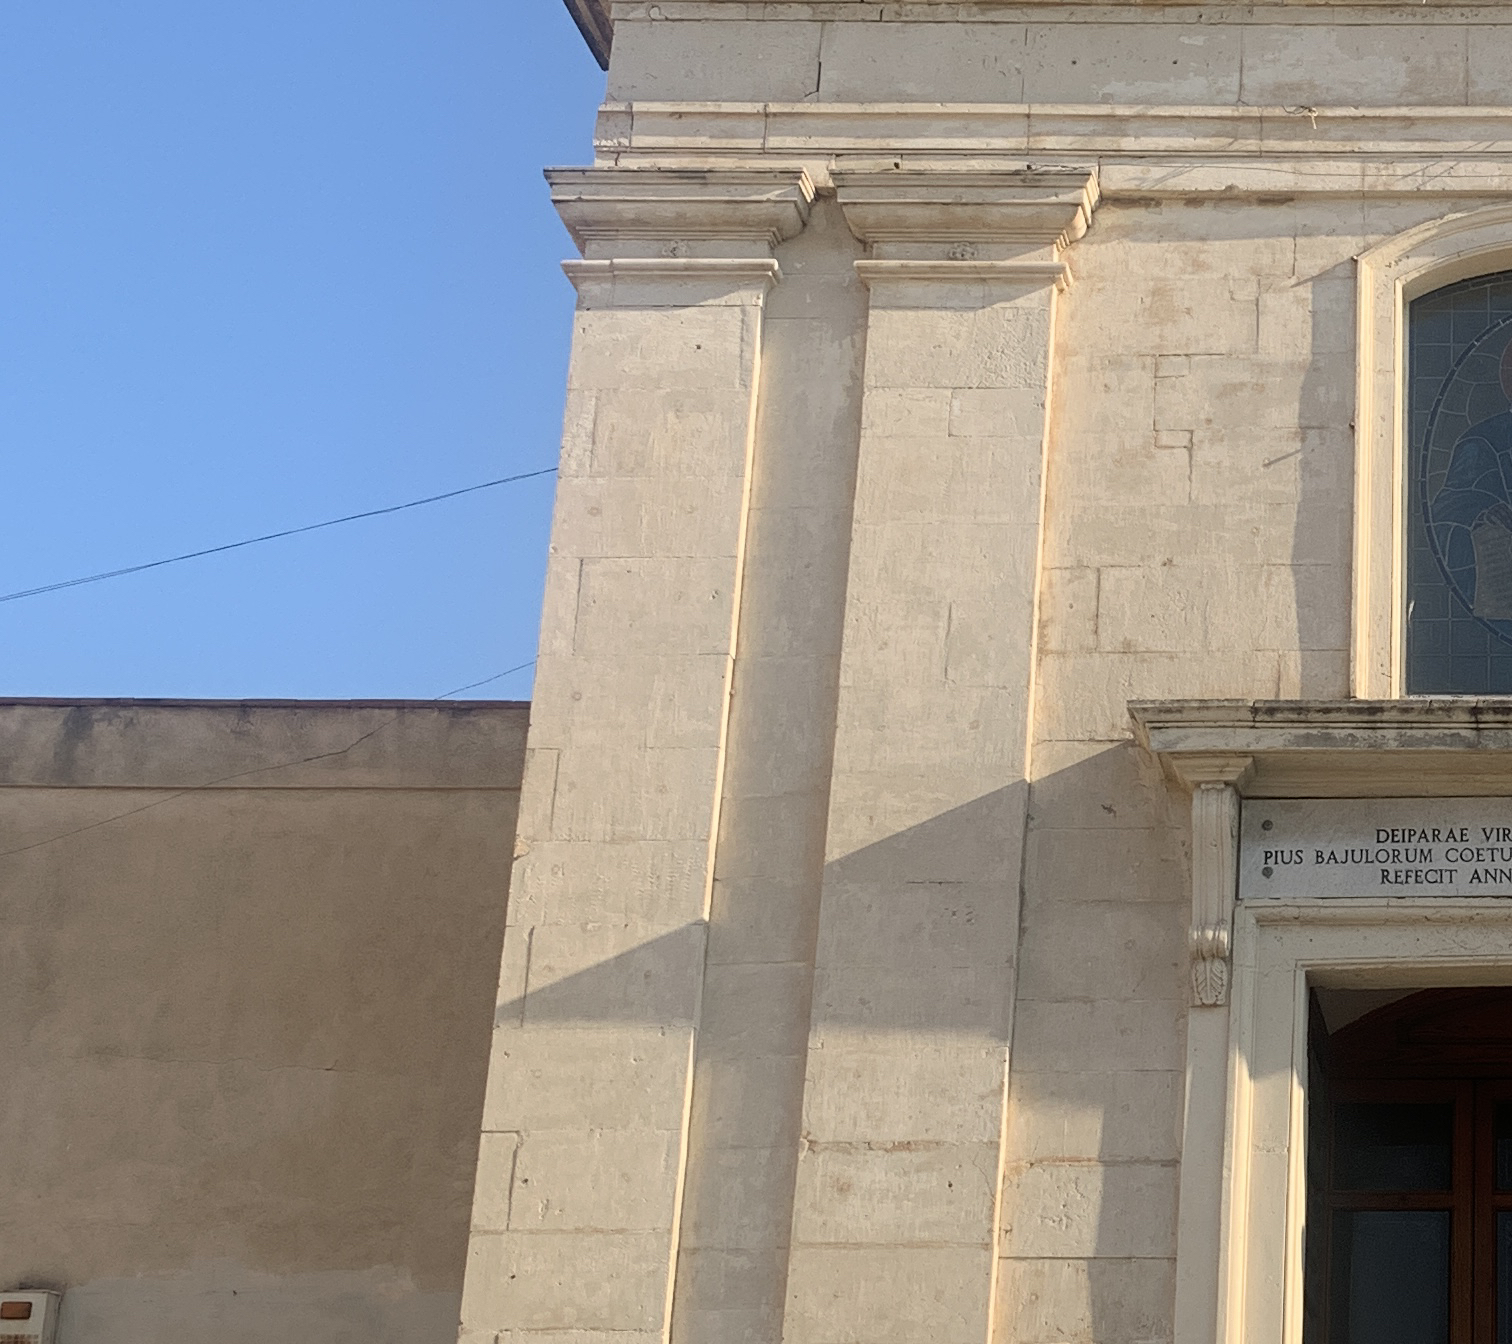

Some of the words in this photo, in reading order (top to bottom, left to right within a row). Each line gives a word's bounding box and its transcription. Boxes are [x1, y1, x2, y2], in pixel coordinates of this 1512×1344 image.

[1375, 828, 1470, 844] DEIPARAE
[1263, 849, 1304, 865] PIUS
[1314, 848, 1433, 865] BAJULORUM
[1380, 868, 1458, 885] REFECIT
